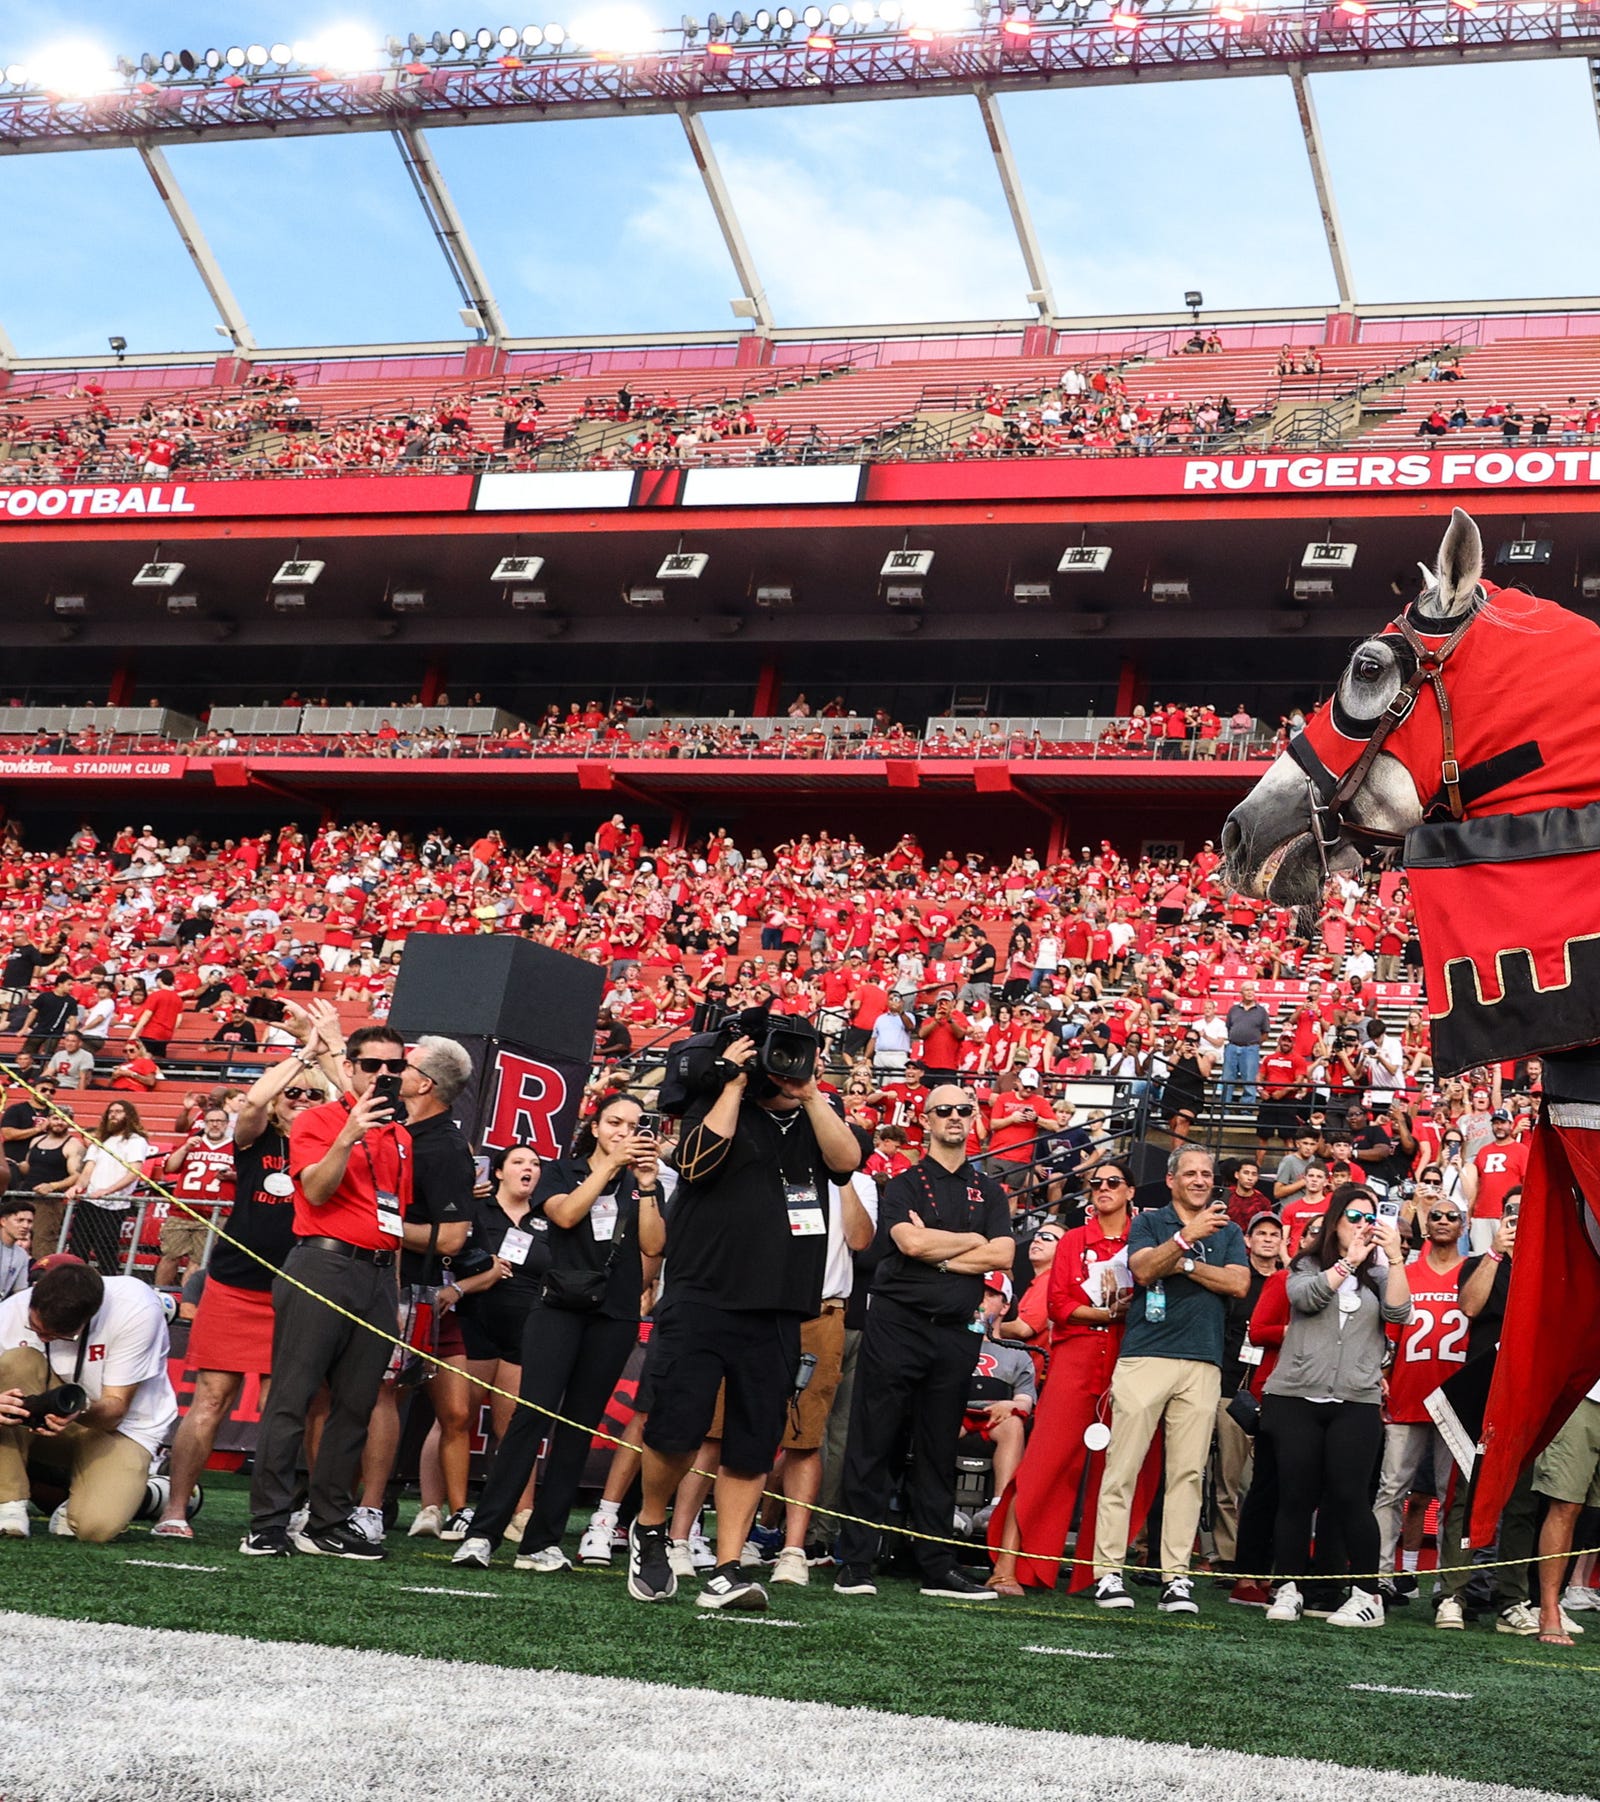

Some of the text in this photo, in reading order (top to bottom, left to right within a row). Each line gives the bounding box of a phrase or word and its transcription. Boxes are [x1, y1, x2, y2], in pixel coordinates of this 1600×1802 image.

[1183, 454, 1431, 490] RUTGERS
[0, 486, 195, 516] FOOTBALL
[73, 763, 131, 774] STADIUM
[135, 763, 170, 774] CLUB
[1147, 844, 1177, 859] 128
[1214, 965, 1225, 976] R
[1237, 965, 1248, 976] R
[1225, 980, 1235, 991] R
[1274, 981, 1285, 992] R
[1376, 984, 1387, 994] R
[1400, 985, 1411, 995] R
[1181, 1000, 1192, 1011] R
[58, 1062, 72, 1076] R
[482, 1050, 567, 1161] R
[186, 1152, 235, 1165] RUTGERS
[1483, 1153, 1507, 1173] R
[182, 1161, 227, 1193] 27
[152, 1202, 170, 1218] R
[120, 1221, 135, 1239] R
[1406, 1309, 1469, 1362] 22
[88, 1344, 105, 1362] R
